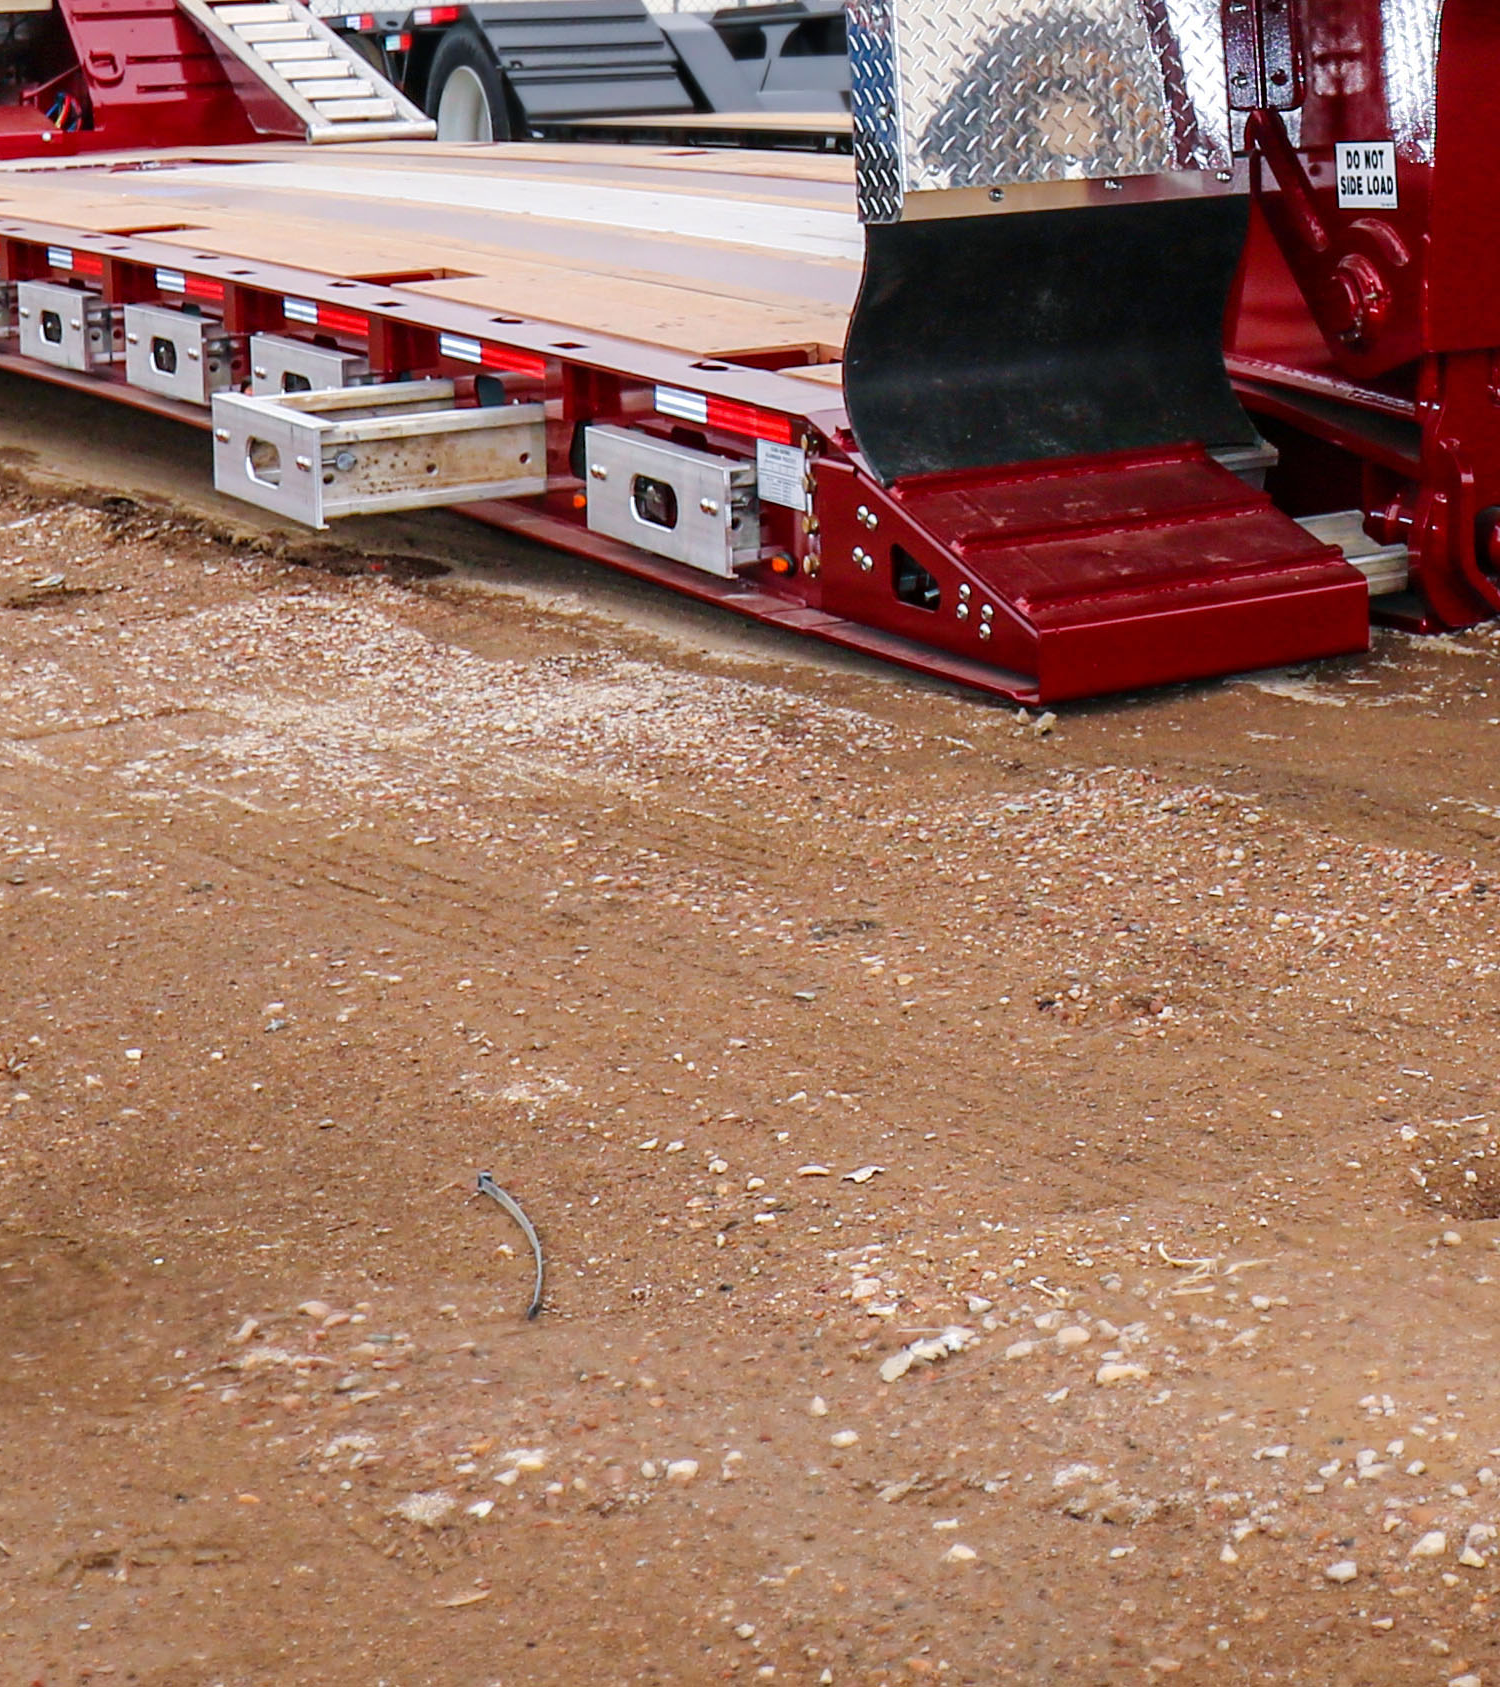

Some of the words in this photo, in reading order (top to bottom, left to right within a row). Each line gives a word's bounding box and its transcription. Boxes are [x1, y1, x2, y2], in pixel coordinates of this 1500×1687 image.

[1346, 149, 1360, 169] DO
[1364, 149, 1384, 169] NOT
[1340, 175, 1363, 196] SIDE
[1367, 175, 1394, 196] LOAD
